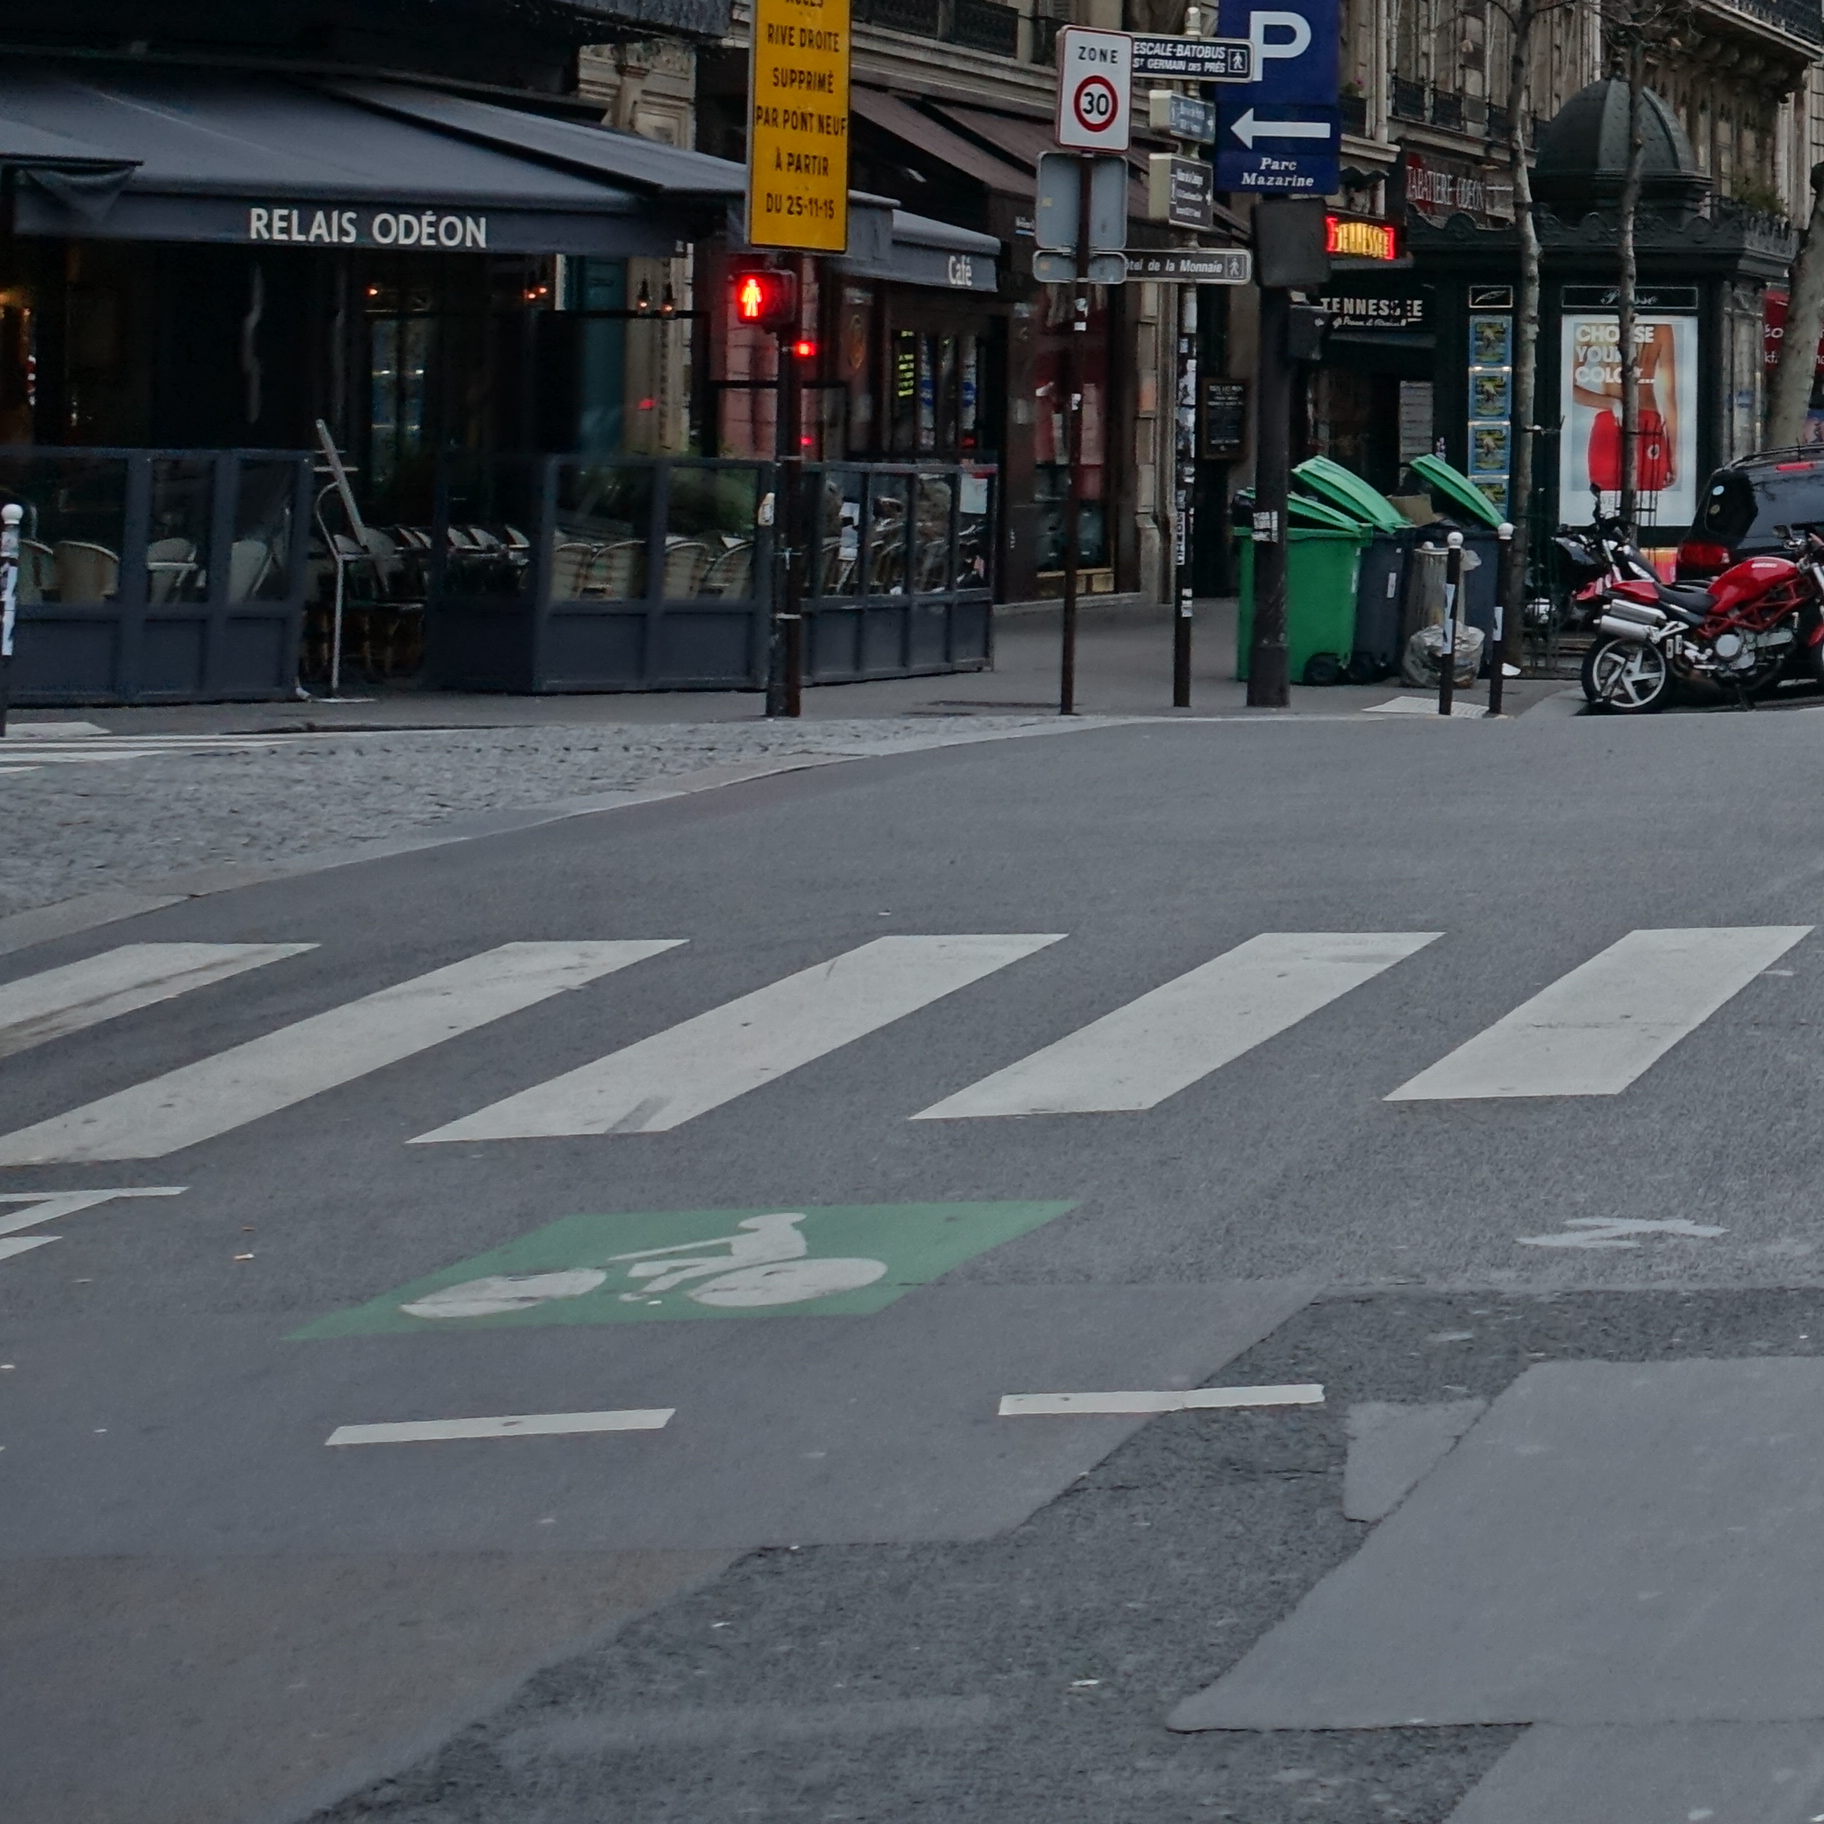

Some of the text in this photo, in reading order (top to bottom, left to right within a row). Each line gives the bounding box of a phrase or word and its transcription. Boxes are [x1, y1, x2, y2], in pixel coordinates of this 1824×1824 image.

[767, 23, 840, 53] RIVE DROITE
[1250, 11, 1312, 81] P
[1078, 45, 1118, 64] ZONE
[1147, 59, 1186, 71] GERMAIN
[1204, 60, 1226, 73] PRÉS
[773, 67, 834, 94] SUPPRIMÉ
[1083, 91, 1110, 116] 30
[756, 105, 847, 137] PAR PONT NEUF
[775, 147, 829, 177] À PARTIR
[1260, 157, 1297, 171] Parc
[1241, 173, 1314, 187] Mazarine
[766, 192, 835, 219] DU 25-11-15
[250, 208, 487, 249] RELAIS ODÉON
[948, 255, 972, 286] Café
[1148, 258, 1161, 272] de
[1165, 258, 1175, 272] la
[1180, 258, 1223, 273] Monnaie
[1576, 325, 1654, 343] CHOSE
